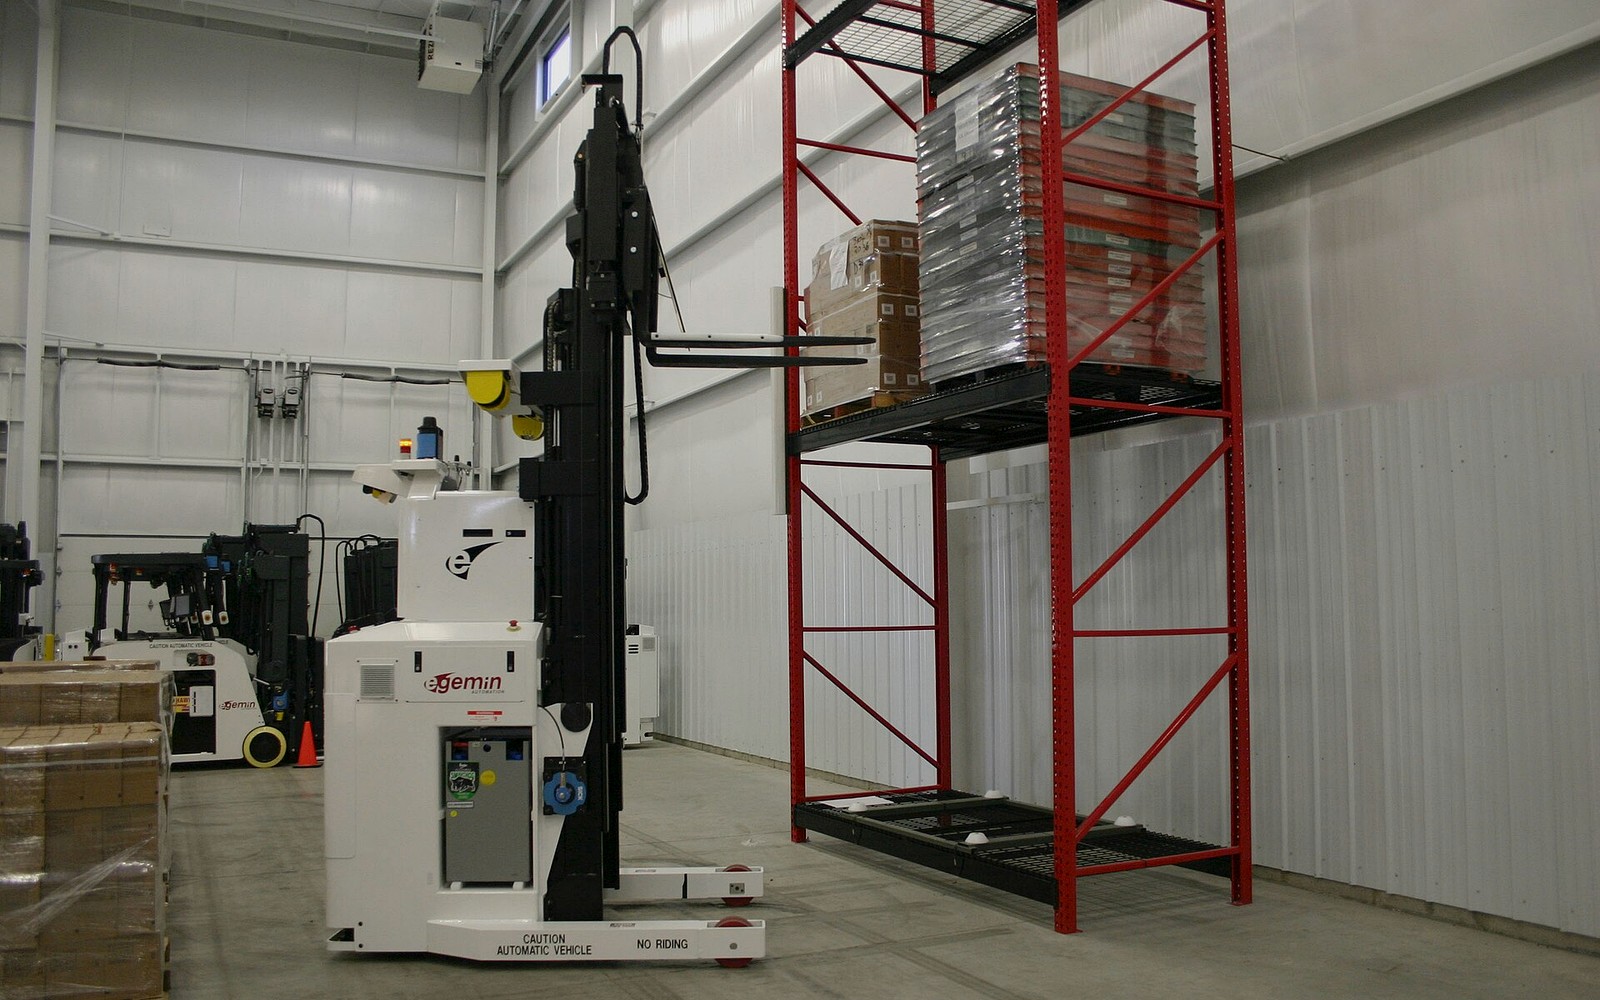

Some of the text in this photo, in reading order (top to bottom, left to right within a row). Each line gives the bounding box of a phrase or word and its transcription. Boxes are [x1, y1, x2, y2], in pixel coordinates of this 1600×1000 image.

[424, 673, 502, 694] egemin
[523, 934, 566, 944] CAUTION
[637, 939, 689, 949] NO RIDING
[497, 945, 592, 955] AUTOMATIC VEHICLE
